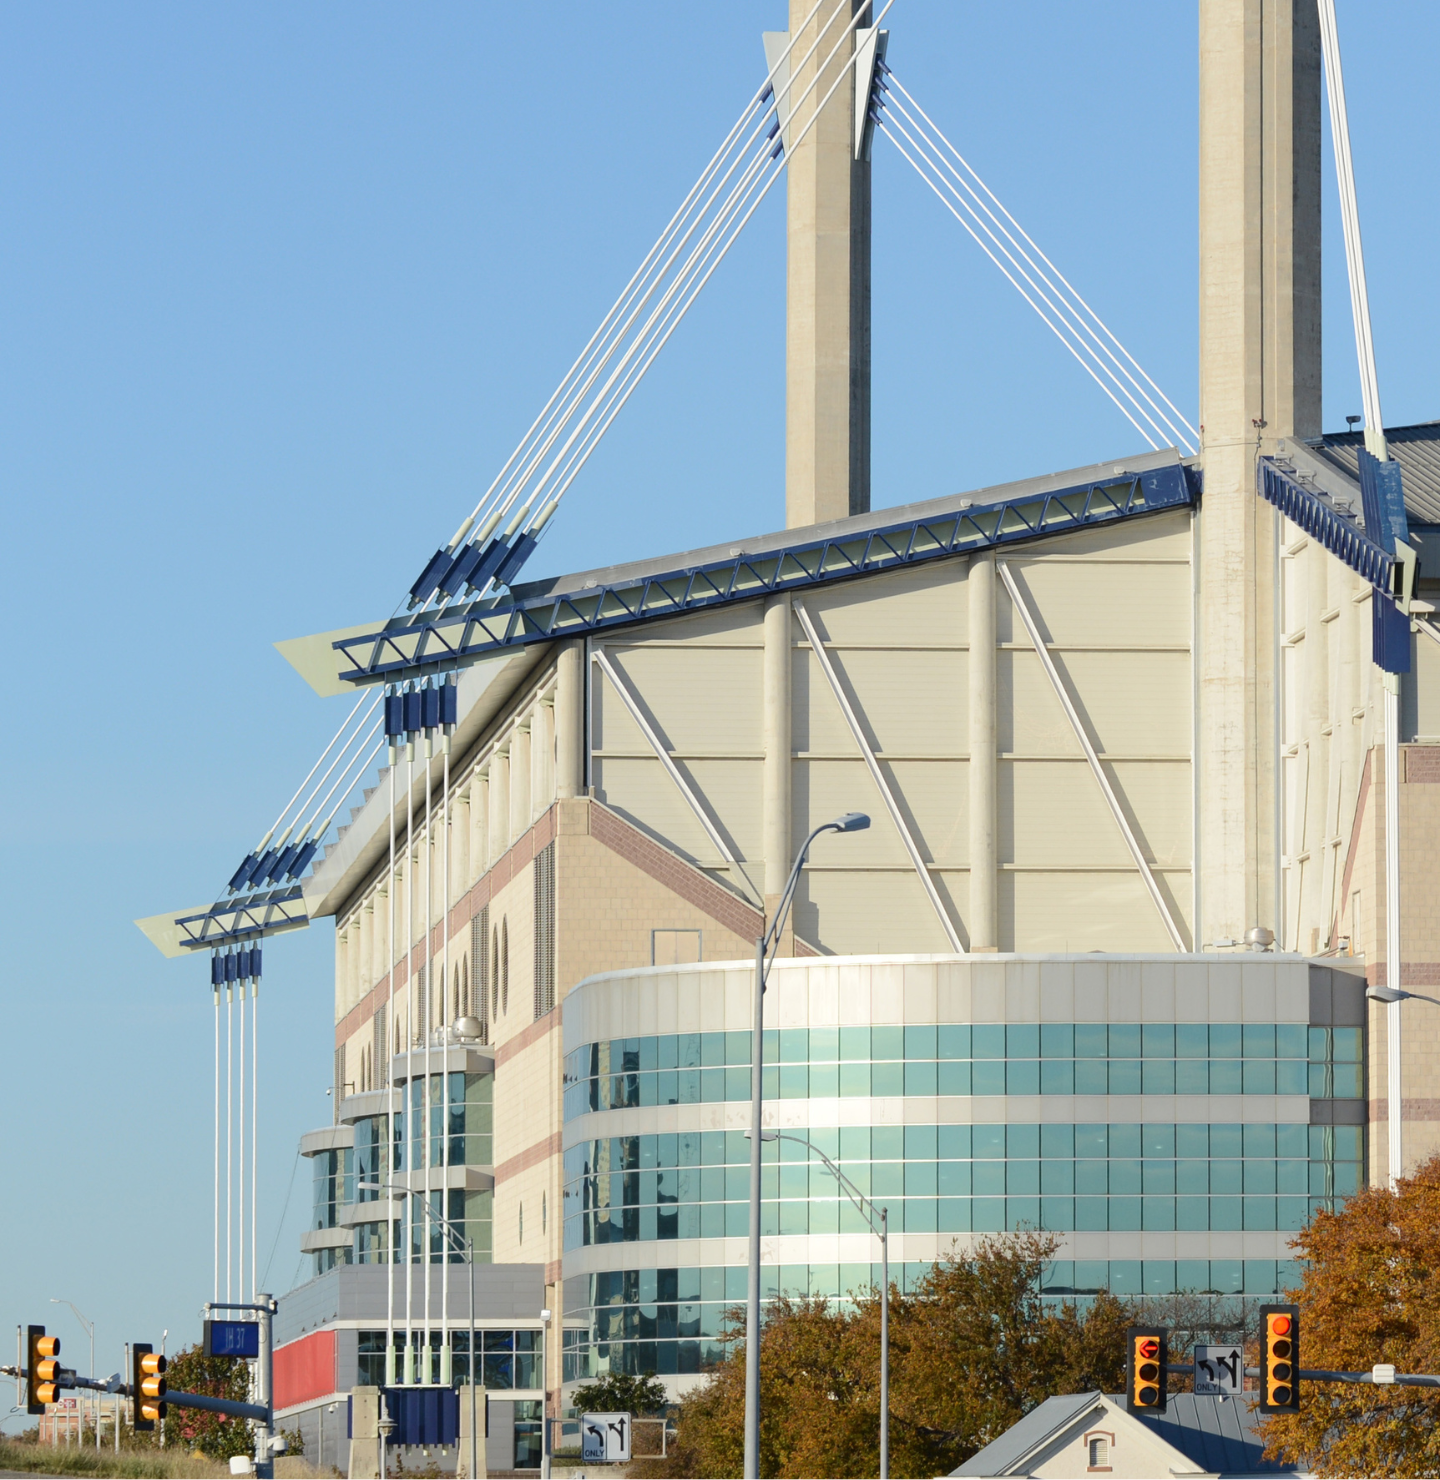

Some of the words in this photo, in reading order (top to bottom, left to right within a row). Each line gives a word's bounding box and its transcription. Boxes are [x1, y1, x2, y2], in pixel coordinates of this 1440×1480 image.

[225, 1327, 234, 1349] IH
[236, 1327, 245, 1349] 37
[1196, 1383, 1217, 1391] ONLY
[584, 1449, 604, 1458] ONLY
